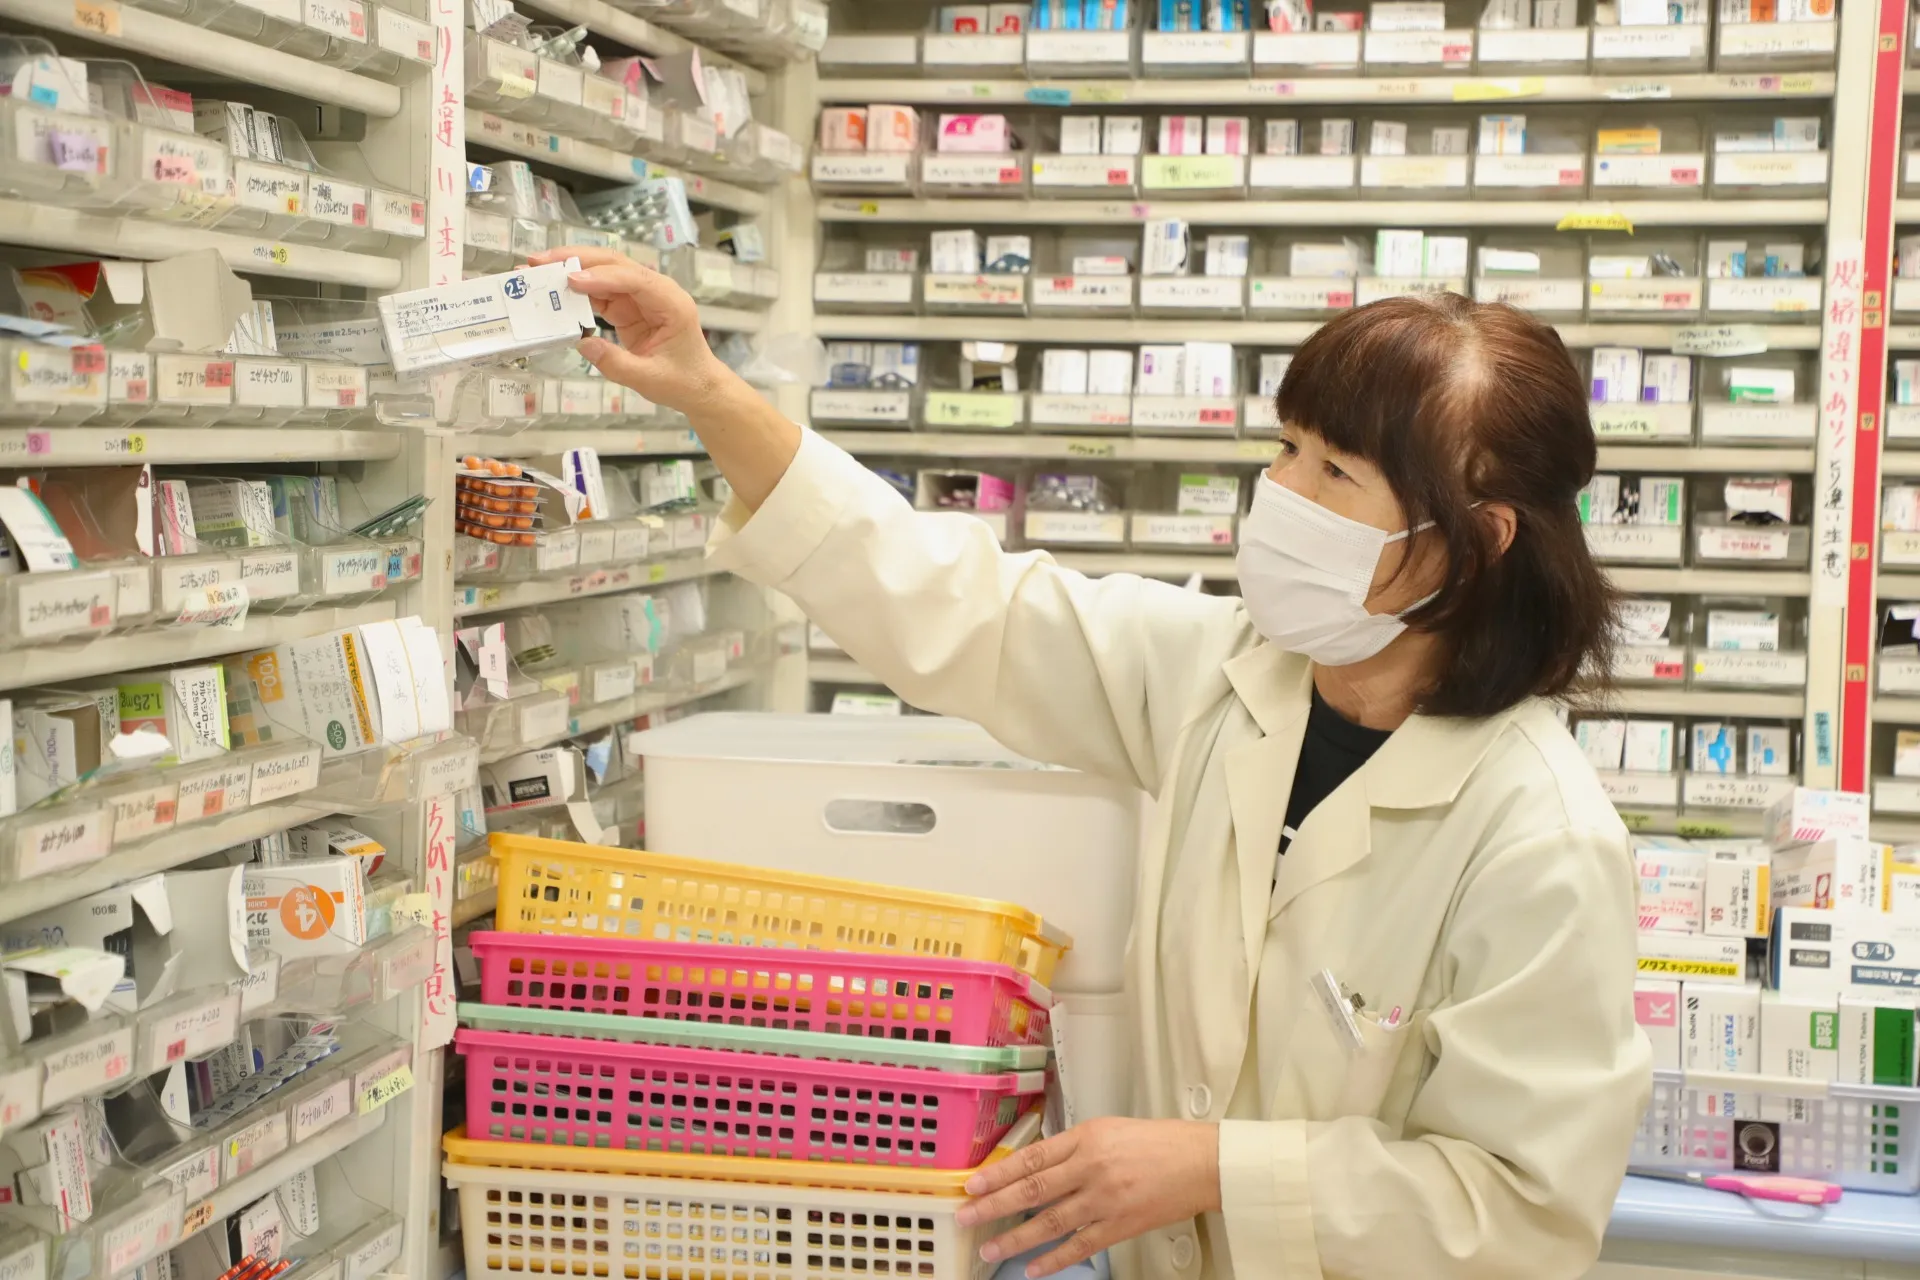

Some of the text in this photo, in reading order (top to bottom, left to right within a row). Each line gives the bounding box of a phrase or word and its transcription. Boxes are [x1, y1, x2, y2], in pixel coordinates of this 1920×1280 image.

[1637, 959, 1738, 976] ノタスチュアブル配合錠
